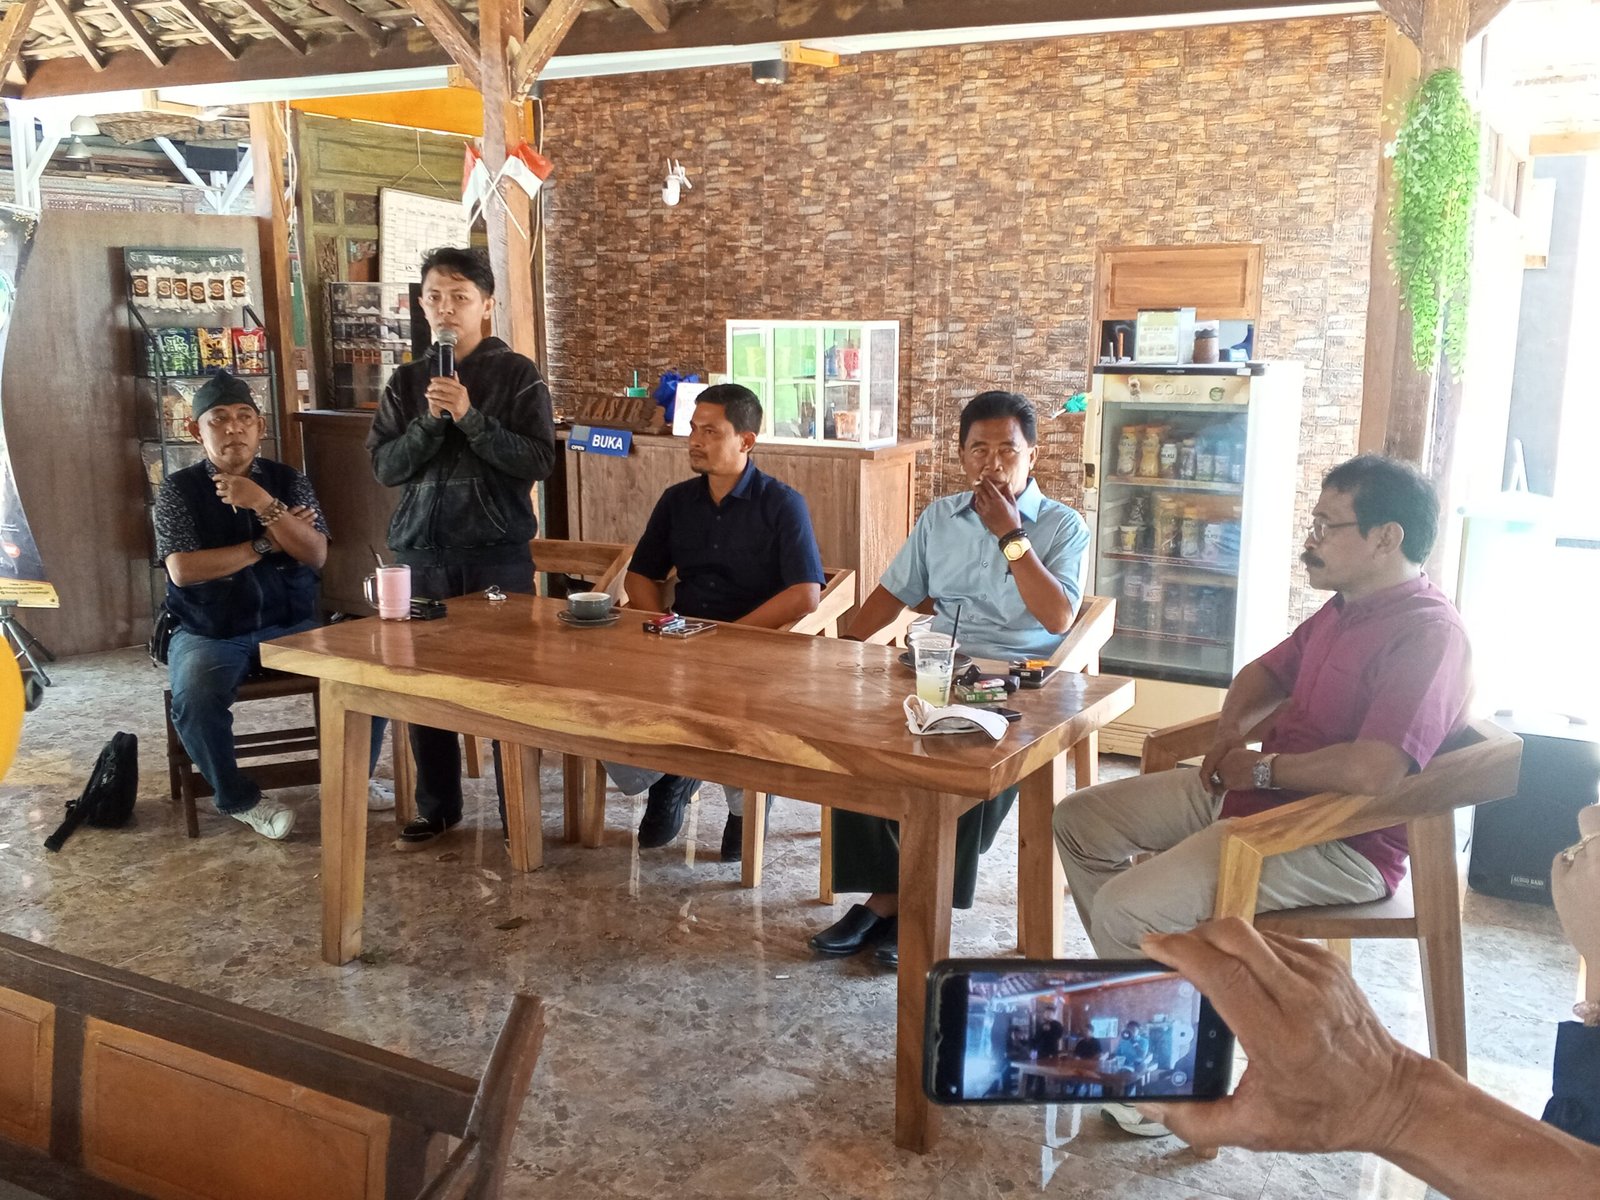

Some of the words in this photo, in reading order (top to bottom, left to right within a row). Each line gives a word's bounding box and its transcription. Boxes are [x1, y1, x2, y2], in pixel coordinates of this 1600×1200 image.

[580, 397, 644, 422] KASIR
[570, 443, 586, 451] OPEN
[591, 434, 624, 451] BUKA
